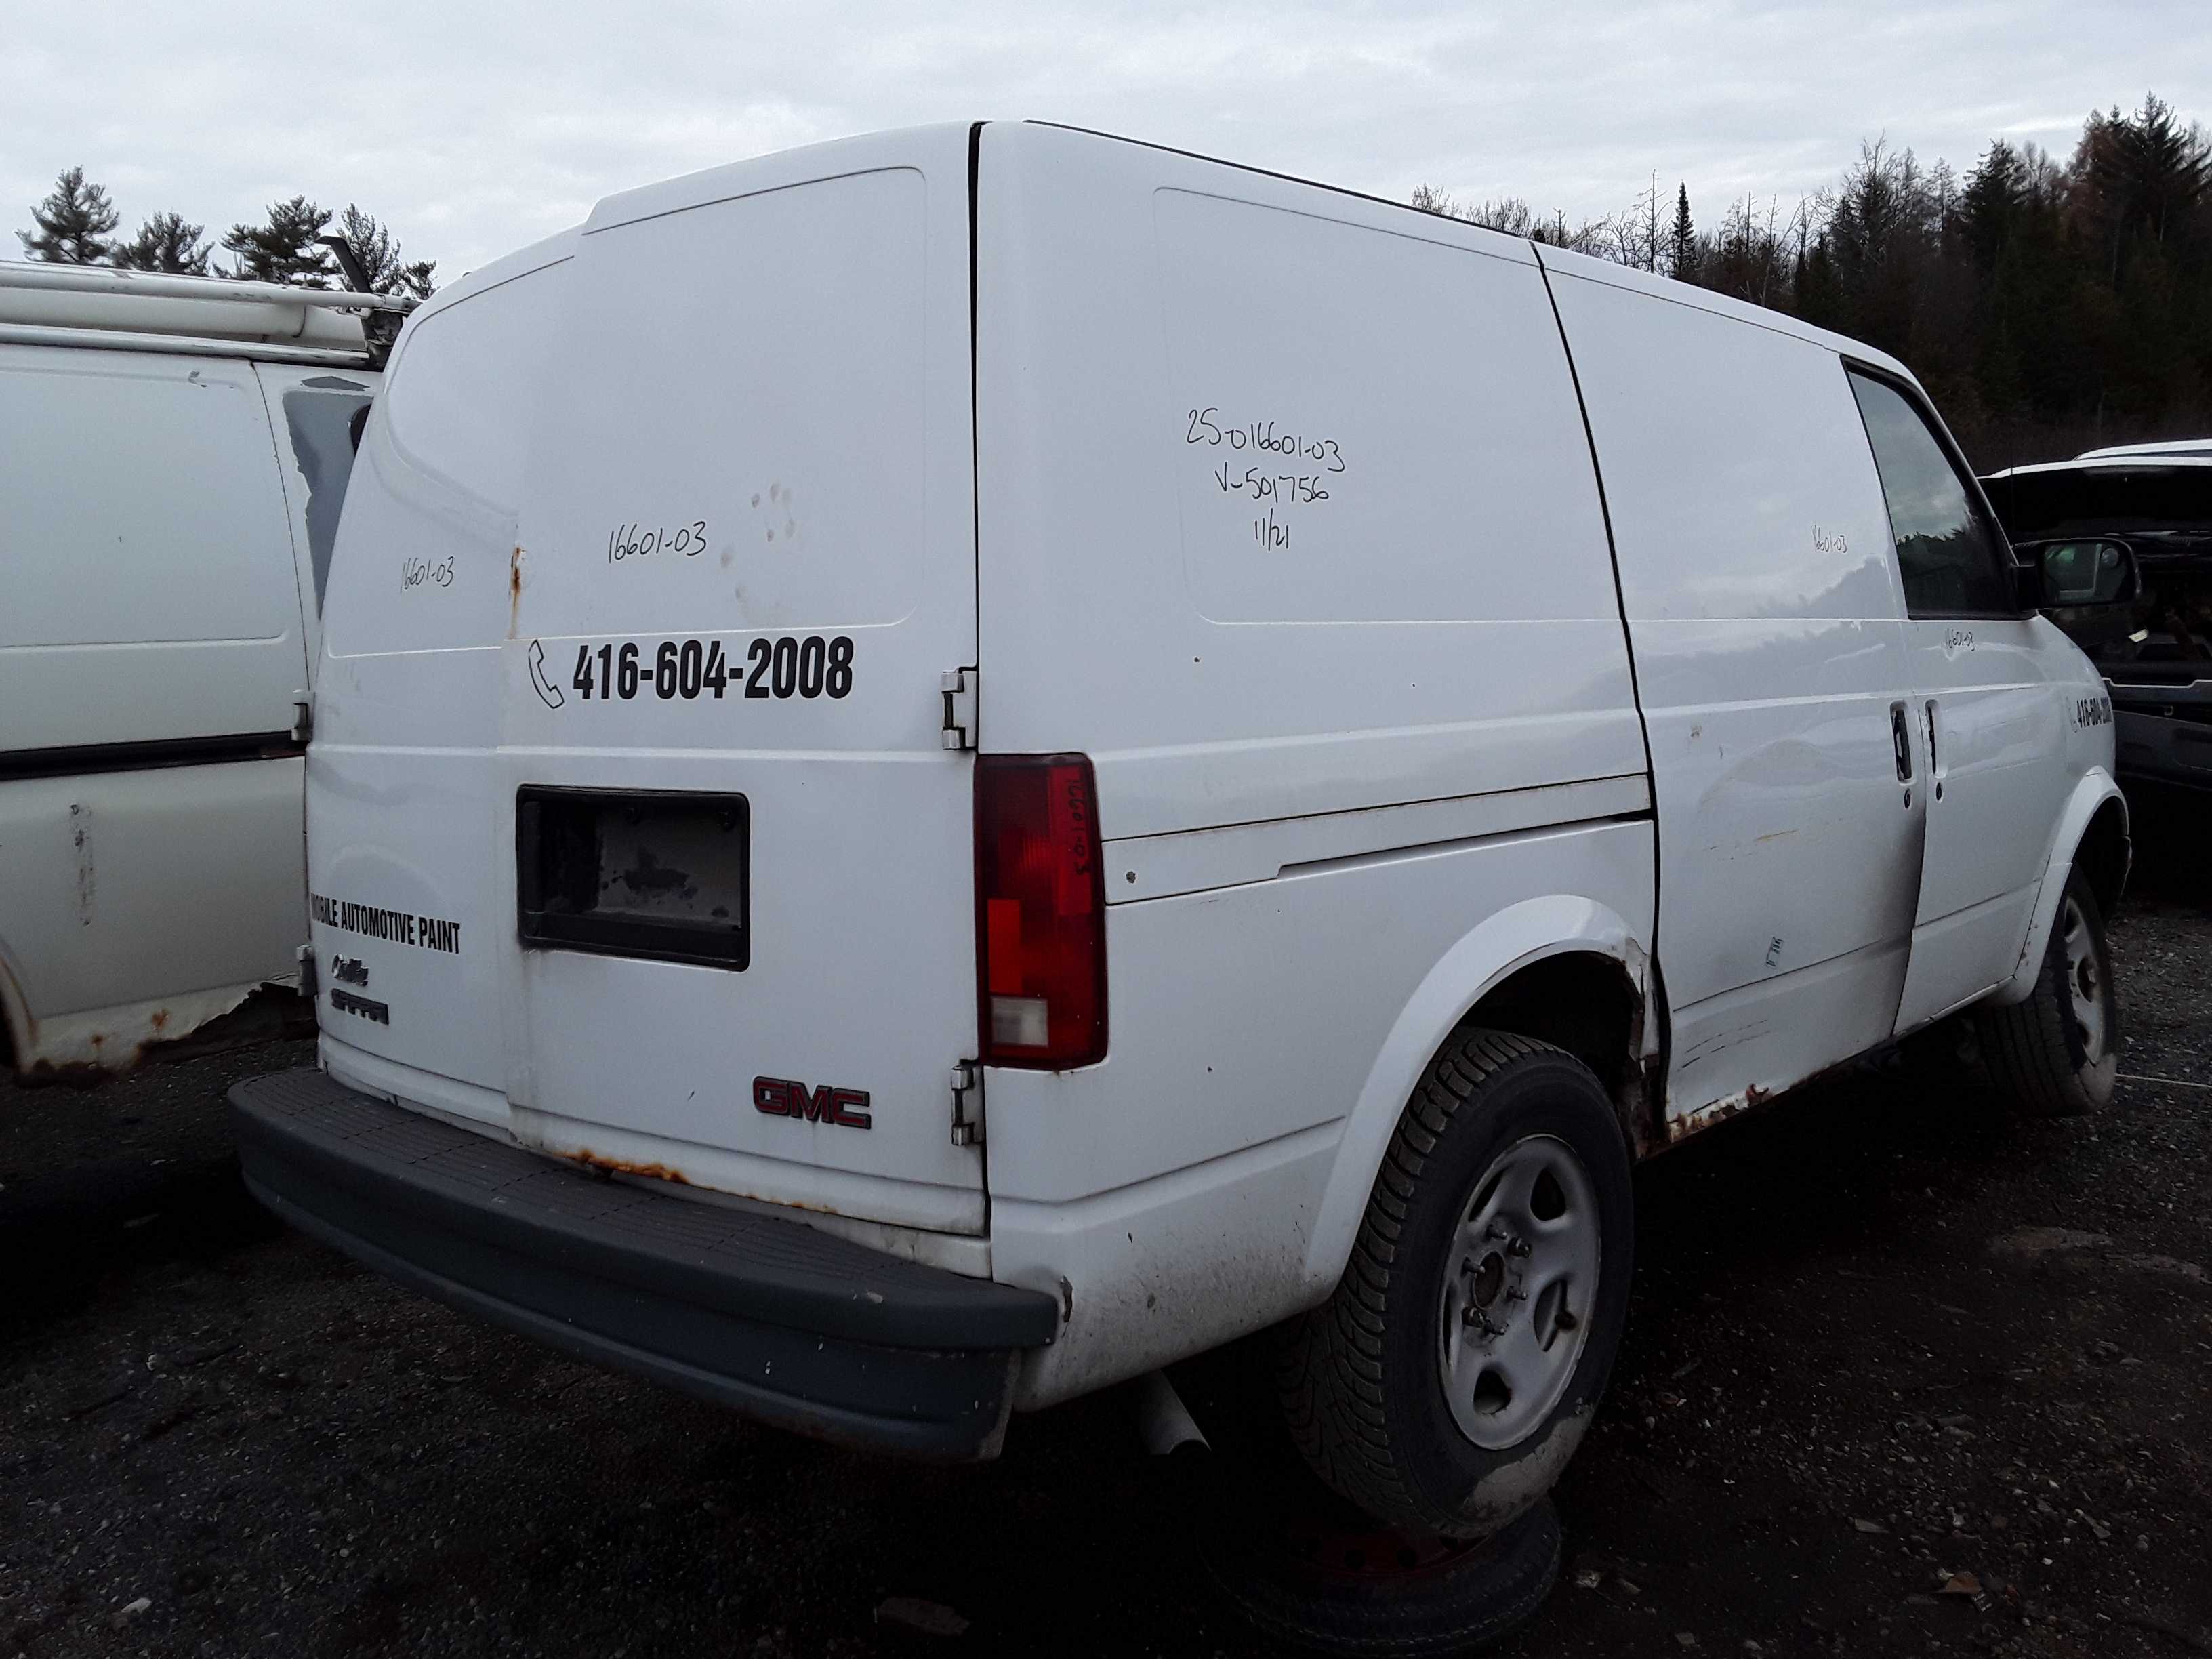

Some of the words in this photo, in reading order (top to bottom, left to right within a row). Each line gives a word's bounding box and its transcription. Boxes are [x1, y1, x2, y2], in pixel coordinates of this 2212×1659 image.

[609, 521, 707, 564] 16601-03
[400, 556, 455, 594] 16601-03
[573, 636, 855, 700] 416-604-2008
[341, 901, 415, 945] AUTOMOTIVE
[418, 916, 461, 954] PAINT
[753, 1076, 872, 1130] GMC
